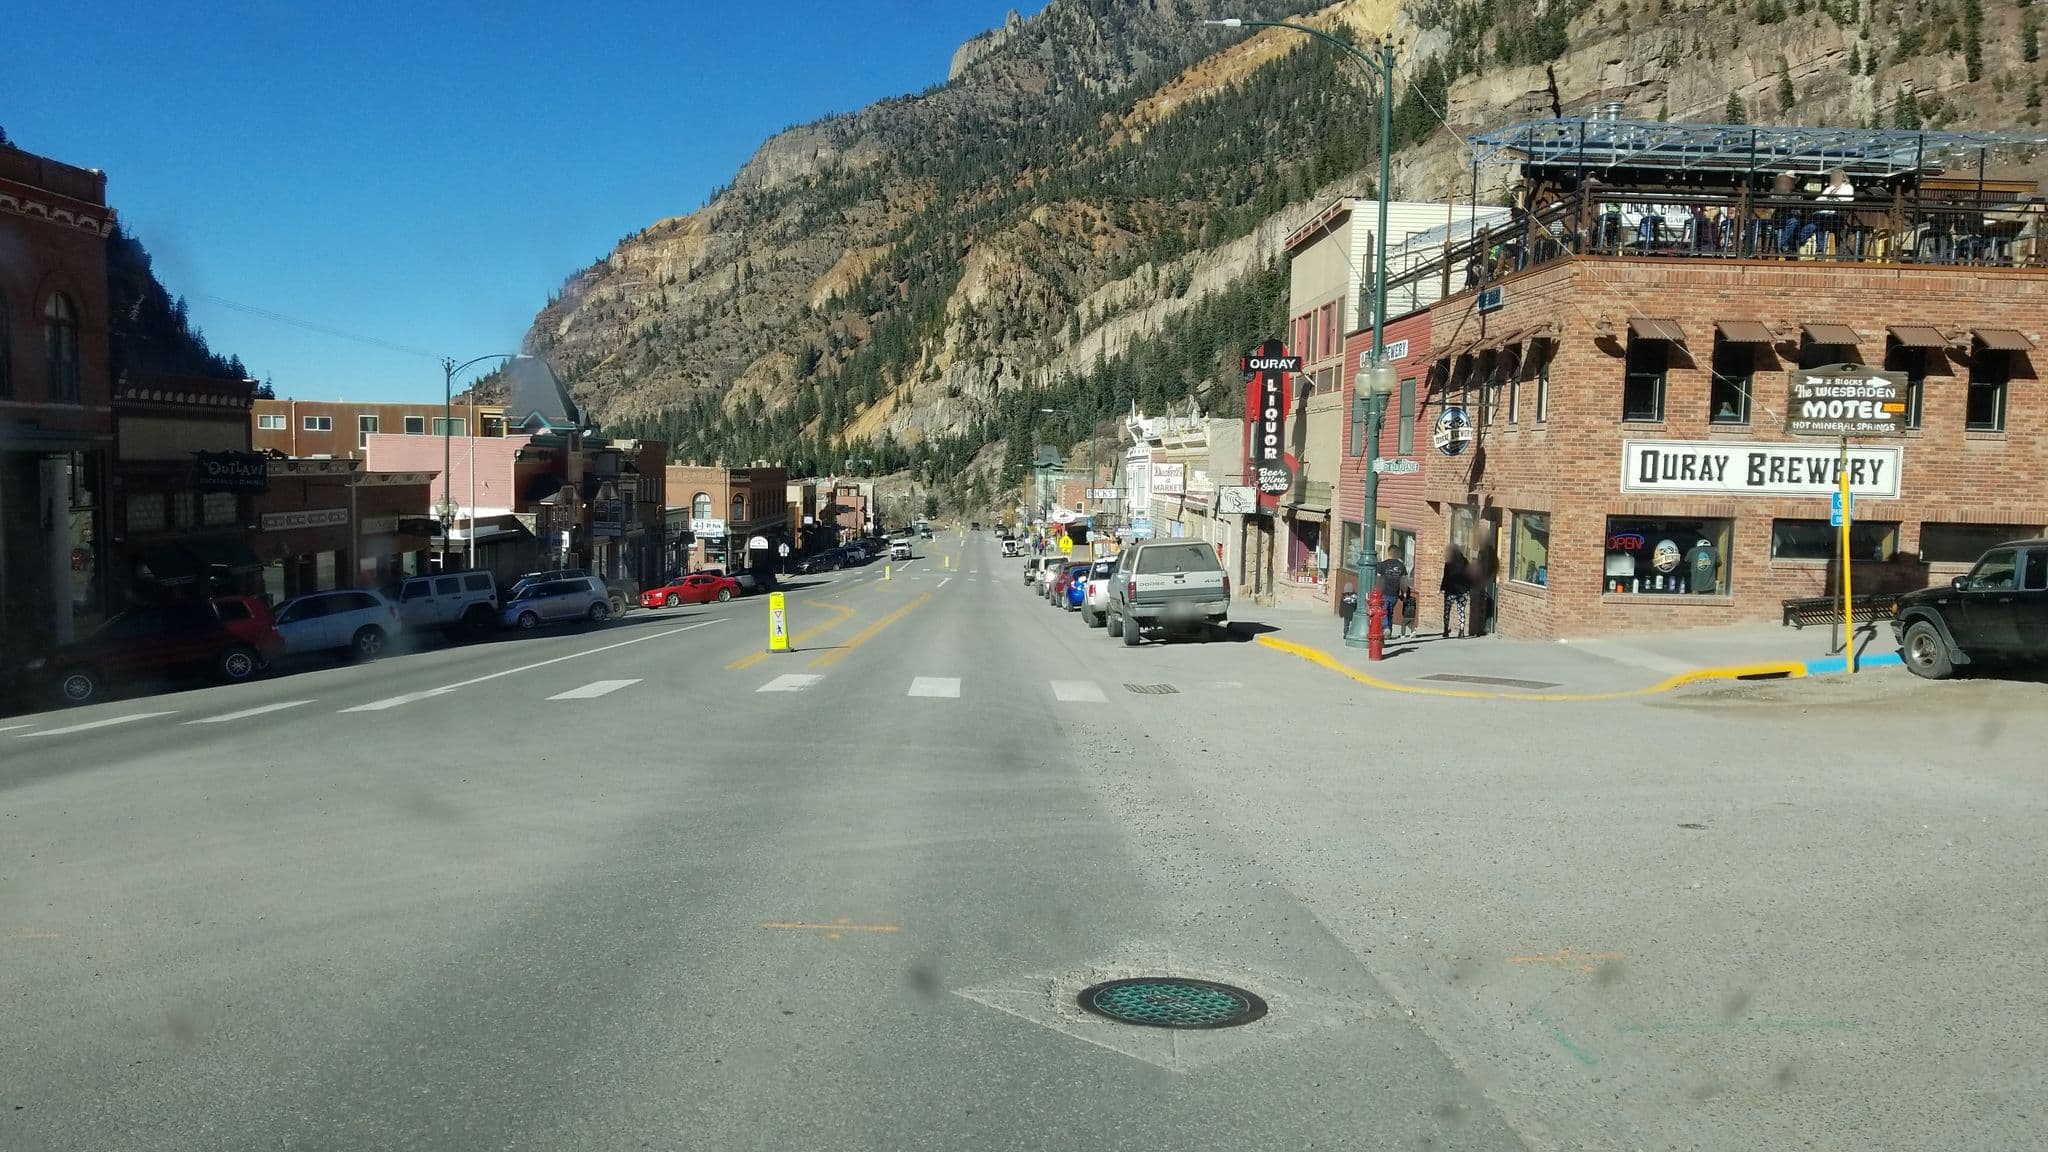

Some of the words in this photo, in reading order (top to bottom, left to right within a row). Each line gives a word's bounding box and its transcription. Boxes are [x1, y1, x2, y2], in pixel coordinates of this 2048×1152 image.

[1250, 359, 1296, 369] OURAY
[1834, 378, 1863, 386] BLOCKS
[1795, 384, 1813, 398] The
[1815, 386, 1896, 398] WIESBADEN
[1803, 400, 1892, 419] MOTEL
[1264, 379, 1278, 460] LIQUOR
[1793, 421, 1811, 429] HOT
[1812, 422, 1856, 431] MINERAL
[1856, 422, 1896, 432] SPRINGS
[1258, 467, 1287, 477] Beer
[1639, 449, 1730, 483] OURAY
[1746, 452, 1884, 486] BREWERY
[1258, 475, 1287, 484] Wine
[1153, 484, 1182, 492] MARKET
[1260, 483, 1289, 493] Spirits
[1607, 537, 1643, 550] OPEN
